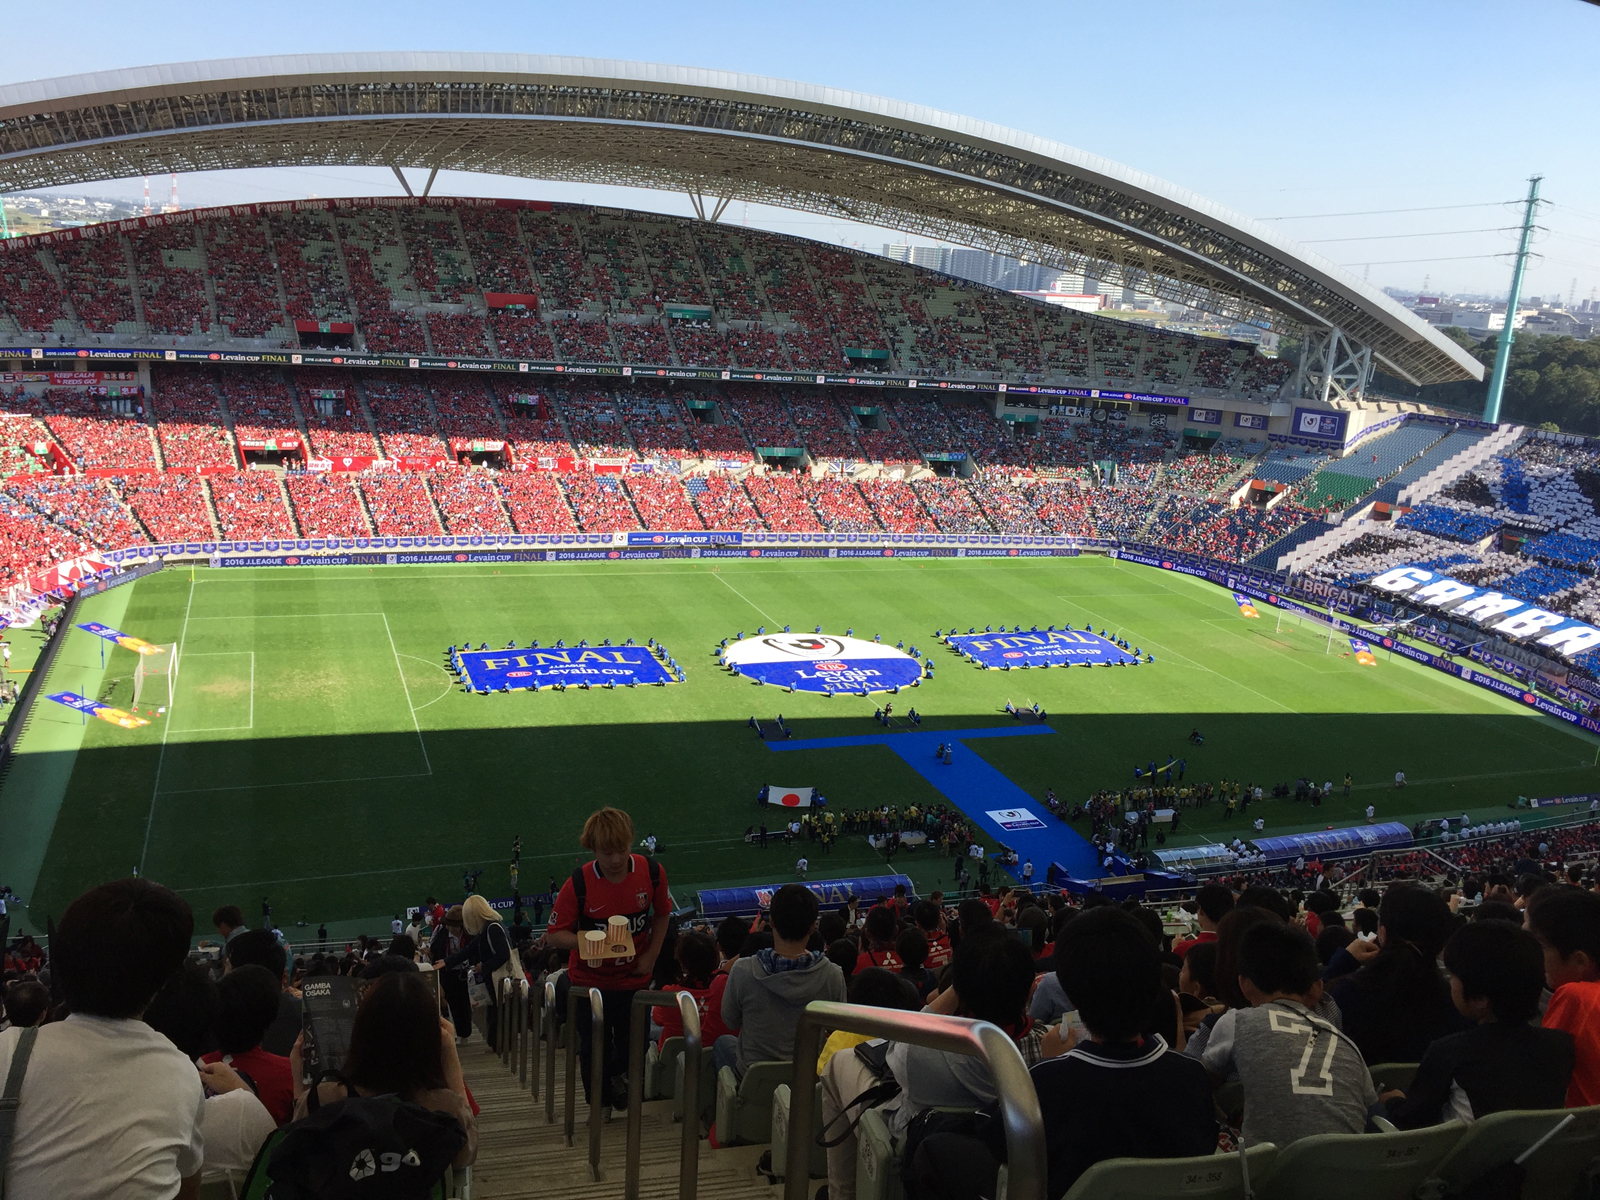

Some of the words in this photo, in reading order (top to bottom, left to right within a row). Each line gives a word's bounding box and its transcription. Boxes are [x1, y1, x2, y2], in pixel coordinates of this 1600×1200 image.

[196, 206, 230, 220] Beside
[296, 200, 328, 210] Always
[334, 198, 351, 208] Yes
[468, 553, 496, 562] Levain
[621, 551, 645, 559] Levain
[1134, 556, 1160, 566] J.LEAGUE
[1172, 564, 1195, 574] Levain
[1209, 572, 1225, 584] FINAL
[1236, 584, 1247, 592] 2016
[1247, 588, 1267, 600] J.LEAGUE
[1277, 599, 1295, 611] Levain
[1303, 580, 1368, 608] BRIGATE
[1370, 566, 1600, 657] GAMBA
[969, 631, 1100, 651] FINAL
[1354, 626, 1380, 642] J.LEAGUE
[1393, 643, 1415, 658] Levain
[1415, 651, 1428, 662] CUP
[1432, 657, 1458, 673] FINAL
[482, 650, 642, 670] FINAL
[1023, 647, 1076, 658] Levain
[536, 667, 601, 676] Levain
[795, 668, 882, 679] Levain
[822, 681, 889, 691] FINAL
[1474, 674, 1490, 685] 2016
[1491, 680, 1521, 698] J.LEAGUE
[1535, 697, 1562, 717] Levain
[1562, 711, 1577, 722] CUP
[595, 914, 647, 933] PUS
[304, 982, 331, 991] GAMBA
[305, 988, 331, 997] OSAKA
